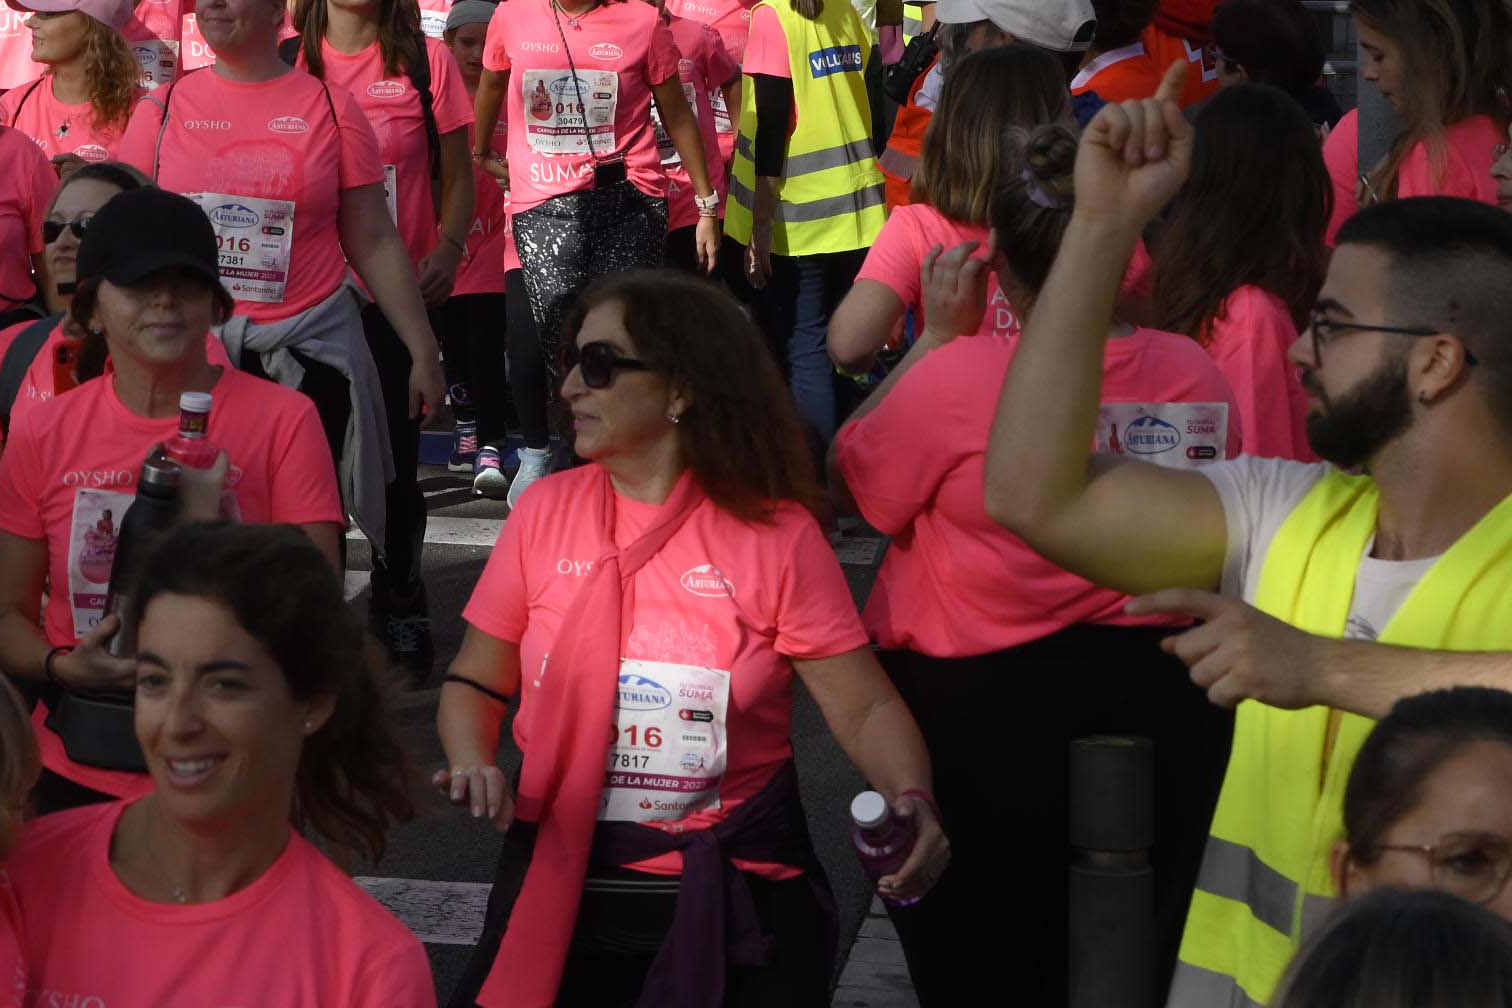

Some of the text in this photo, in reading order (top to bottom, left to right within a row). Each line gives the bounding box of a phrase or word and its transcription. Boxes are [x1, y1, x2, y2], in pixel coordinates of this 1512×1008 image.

[521, 41, 560, 53] OYSHO
[555, 102, 585, 114] 016
[184, 119, 232, 130] OYSHO
[558, 117, 584, 126] 30479
[212, 210, 256, 224] ASTURIANA
[1187, 425, 1217, 435] SUMA
[63, 469, 133, 487] OYSHO
[679, 688, 713, 700] SUMA
[611, 753, 650, 769] 7817
[611, 775, 624, 784] DE
[627, 776, 641, 785] LA
[643, 778, 680, 789] MUJER
